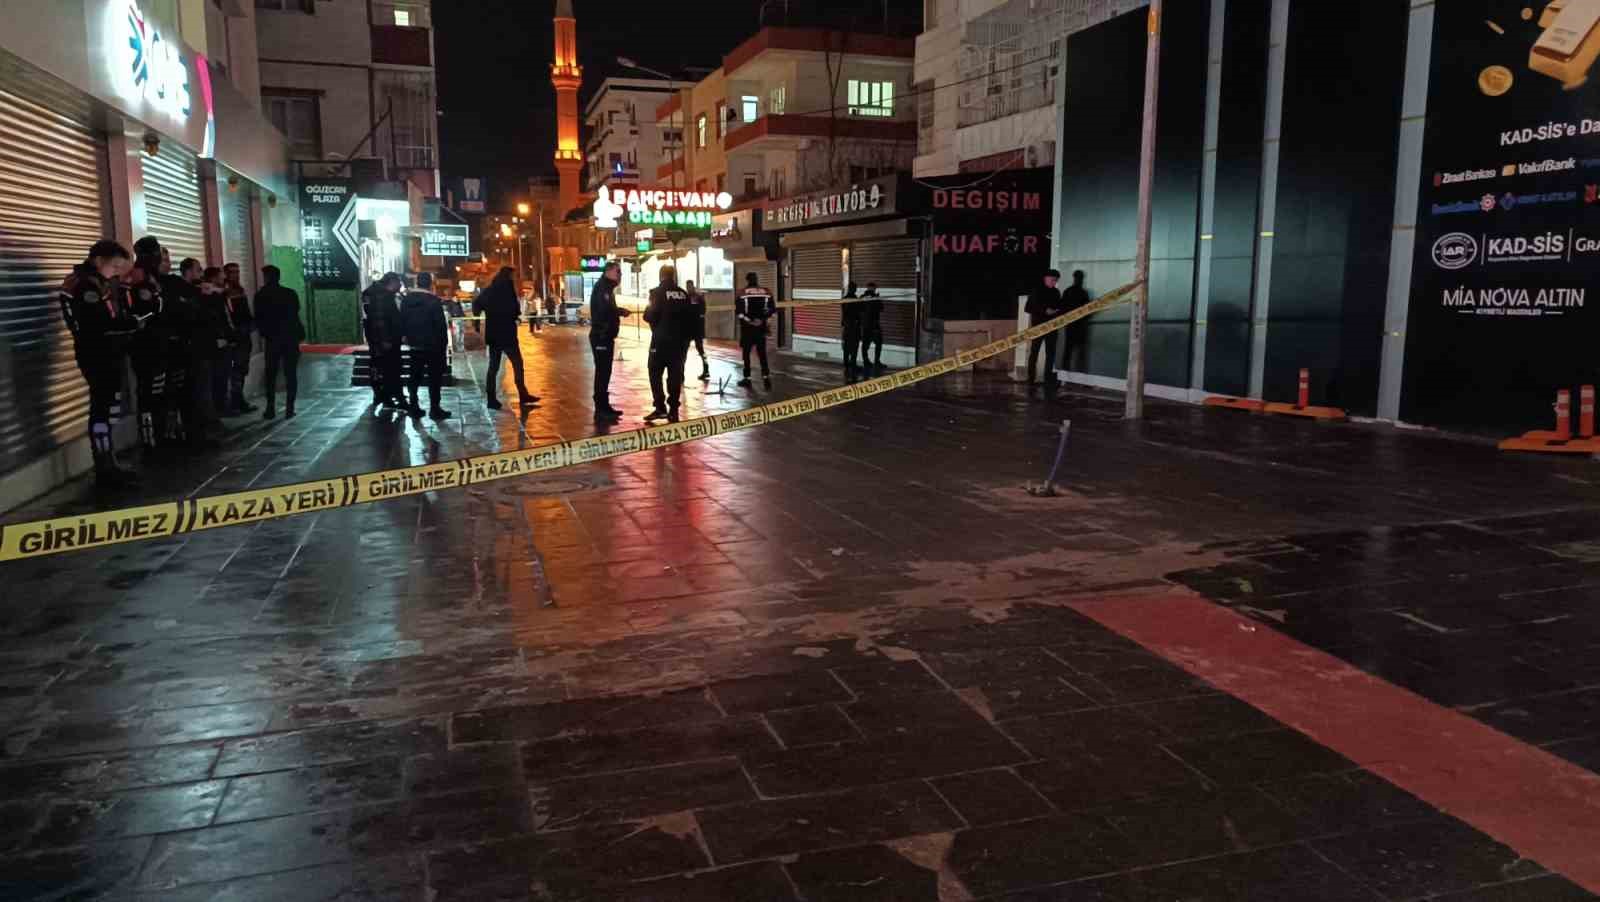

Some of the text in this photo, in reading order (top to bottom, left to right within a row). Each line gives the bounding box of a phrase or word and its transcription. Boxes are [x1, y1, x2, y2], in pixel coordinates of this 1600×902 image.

[1500, 122, 1576, 146] KAD-SİS'e
[313, 195, 340, 203] PLAZA
[1443, 246, 1465, 256] IAR
[1488, 232, 1564, 255] KAD-SİS
[1443, 285, 1475, 306] MİA
[1534, 288, 1585, 306] ALTIN
[20, 512, 168, 553] GİRİLMEZ
[202, 498, 276, 526] KAZA
[283, 482, 334, 512] YERİ
[369, 468, 455, 497] GİRİLMEZ
[475, 463, 521, 481] KAZA
[524, 447, 557, 469] YERİ
[579, 436, 637, 460] GİRİLMEZ
[647, 428, 681, 447] KAZA
[682, 421, 708, 439] YERİ
[721, 410, 762, 431] GİRİLMEZ
[769, 404, 793, 417] KAZA
